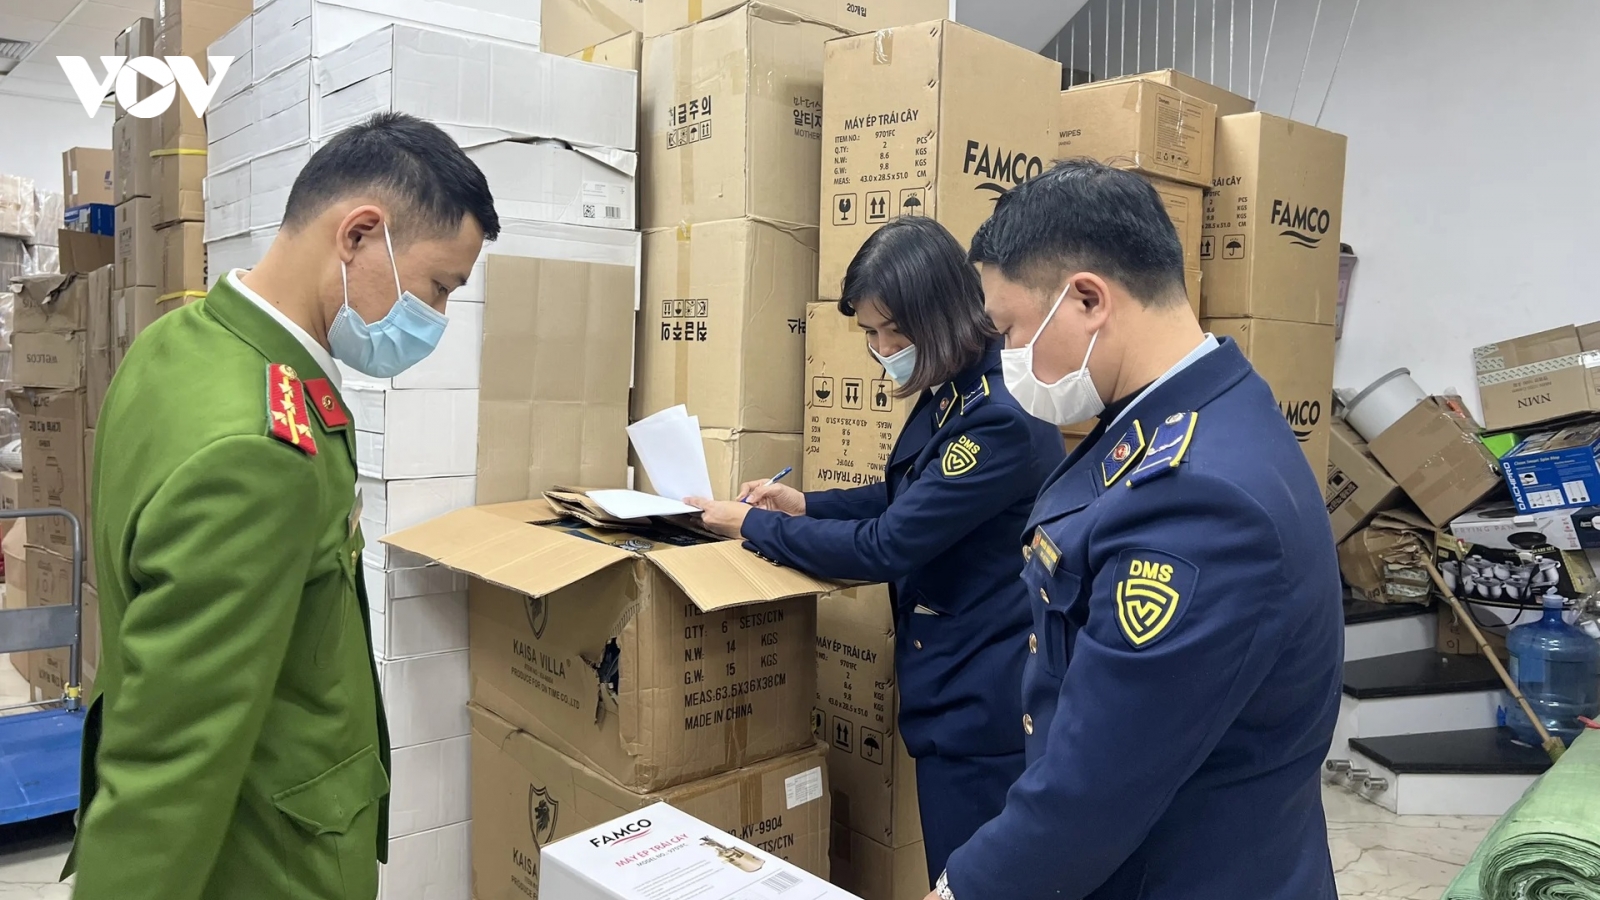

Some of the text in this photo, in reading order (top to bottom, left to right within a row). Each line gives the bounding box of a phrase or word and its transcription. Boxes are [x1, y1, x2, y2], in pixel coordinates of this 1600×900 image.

[847, 3, 867, 18] 20개입
[844, 108, 919, 130] MÁY ÉP TRÁI CÂY
[875, 129, 895, 138] 9701FC
[1059, 129, 1081, 138] WIPES
[834, 146, 848, 155] Q.TY:
[917, 136, 927, 144] PCS
[880, 152, 890, 160] 8.6
[963, 140, 1042, 185] FAMCO
[834, 177, 850, 185] MEAS:
[860, 175, 872, 183] 43.0
[878, 173, 890, 181] 28.5
[917, 170, 926, 178] CM
[1211, 176, 1242, 186] RÁI CÂY
[1271, 199, 1330, 234] FAMCO
[661, 322, 707, 341] 취급주의
[1518, 393, 1551, 408] NMN
[826, 417, 836, 425] 51.0
[1279, 400, 1320, 425] MCO
[958, 435, 981, 455] DMS
[837, 459, 854, 467] 9701FC
[818, 469, 832, 481] CÂY
[834, 471, 850, 483] TRÁI
[852, 473, 861, 485] ÉP
[1454, 526, 1490, 535] FRYING
[1129, 560, 1174, 583] DMS
[685, 610, 784, 639] QTY: 6 SETS/CTN
[685, 632, 778, 662] N.W: 14 KGS
[833, 639, 841, 652] ÉP
[843, 644, 860, 659] TRÁI
[861, 649, 877, 664] CÂY
[513, 639, 537, 665] KAISA
[540, 652, 566, 679] VILLA
[685, 653, 777, 684] G.W: 15 KGS
[840, 660, 857, 670] 9701FC
[511, 666, 532, 685] PRODUCE
[532, 678, 540, 688] FOR
[548, 687, 560, 699] TIME
[844, 681, 884, 700] 8.6 KGS
[875, 681, 885, 689] PCS
[685, 703, 752, 730] MADE IN CHINA
[874, 703, 884, 712] KGS
[590, 819, 652, 847] FAMCO
[615, 833, 689, 867] MÁY ÉP TRÁI CÂY
[513, 847, 538, 880] KAISA
[636, 856, 657, 866] MODEL
